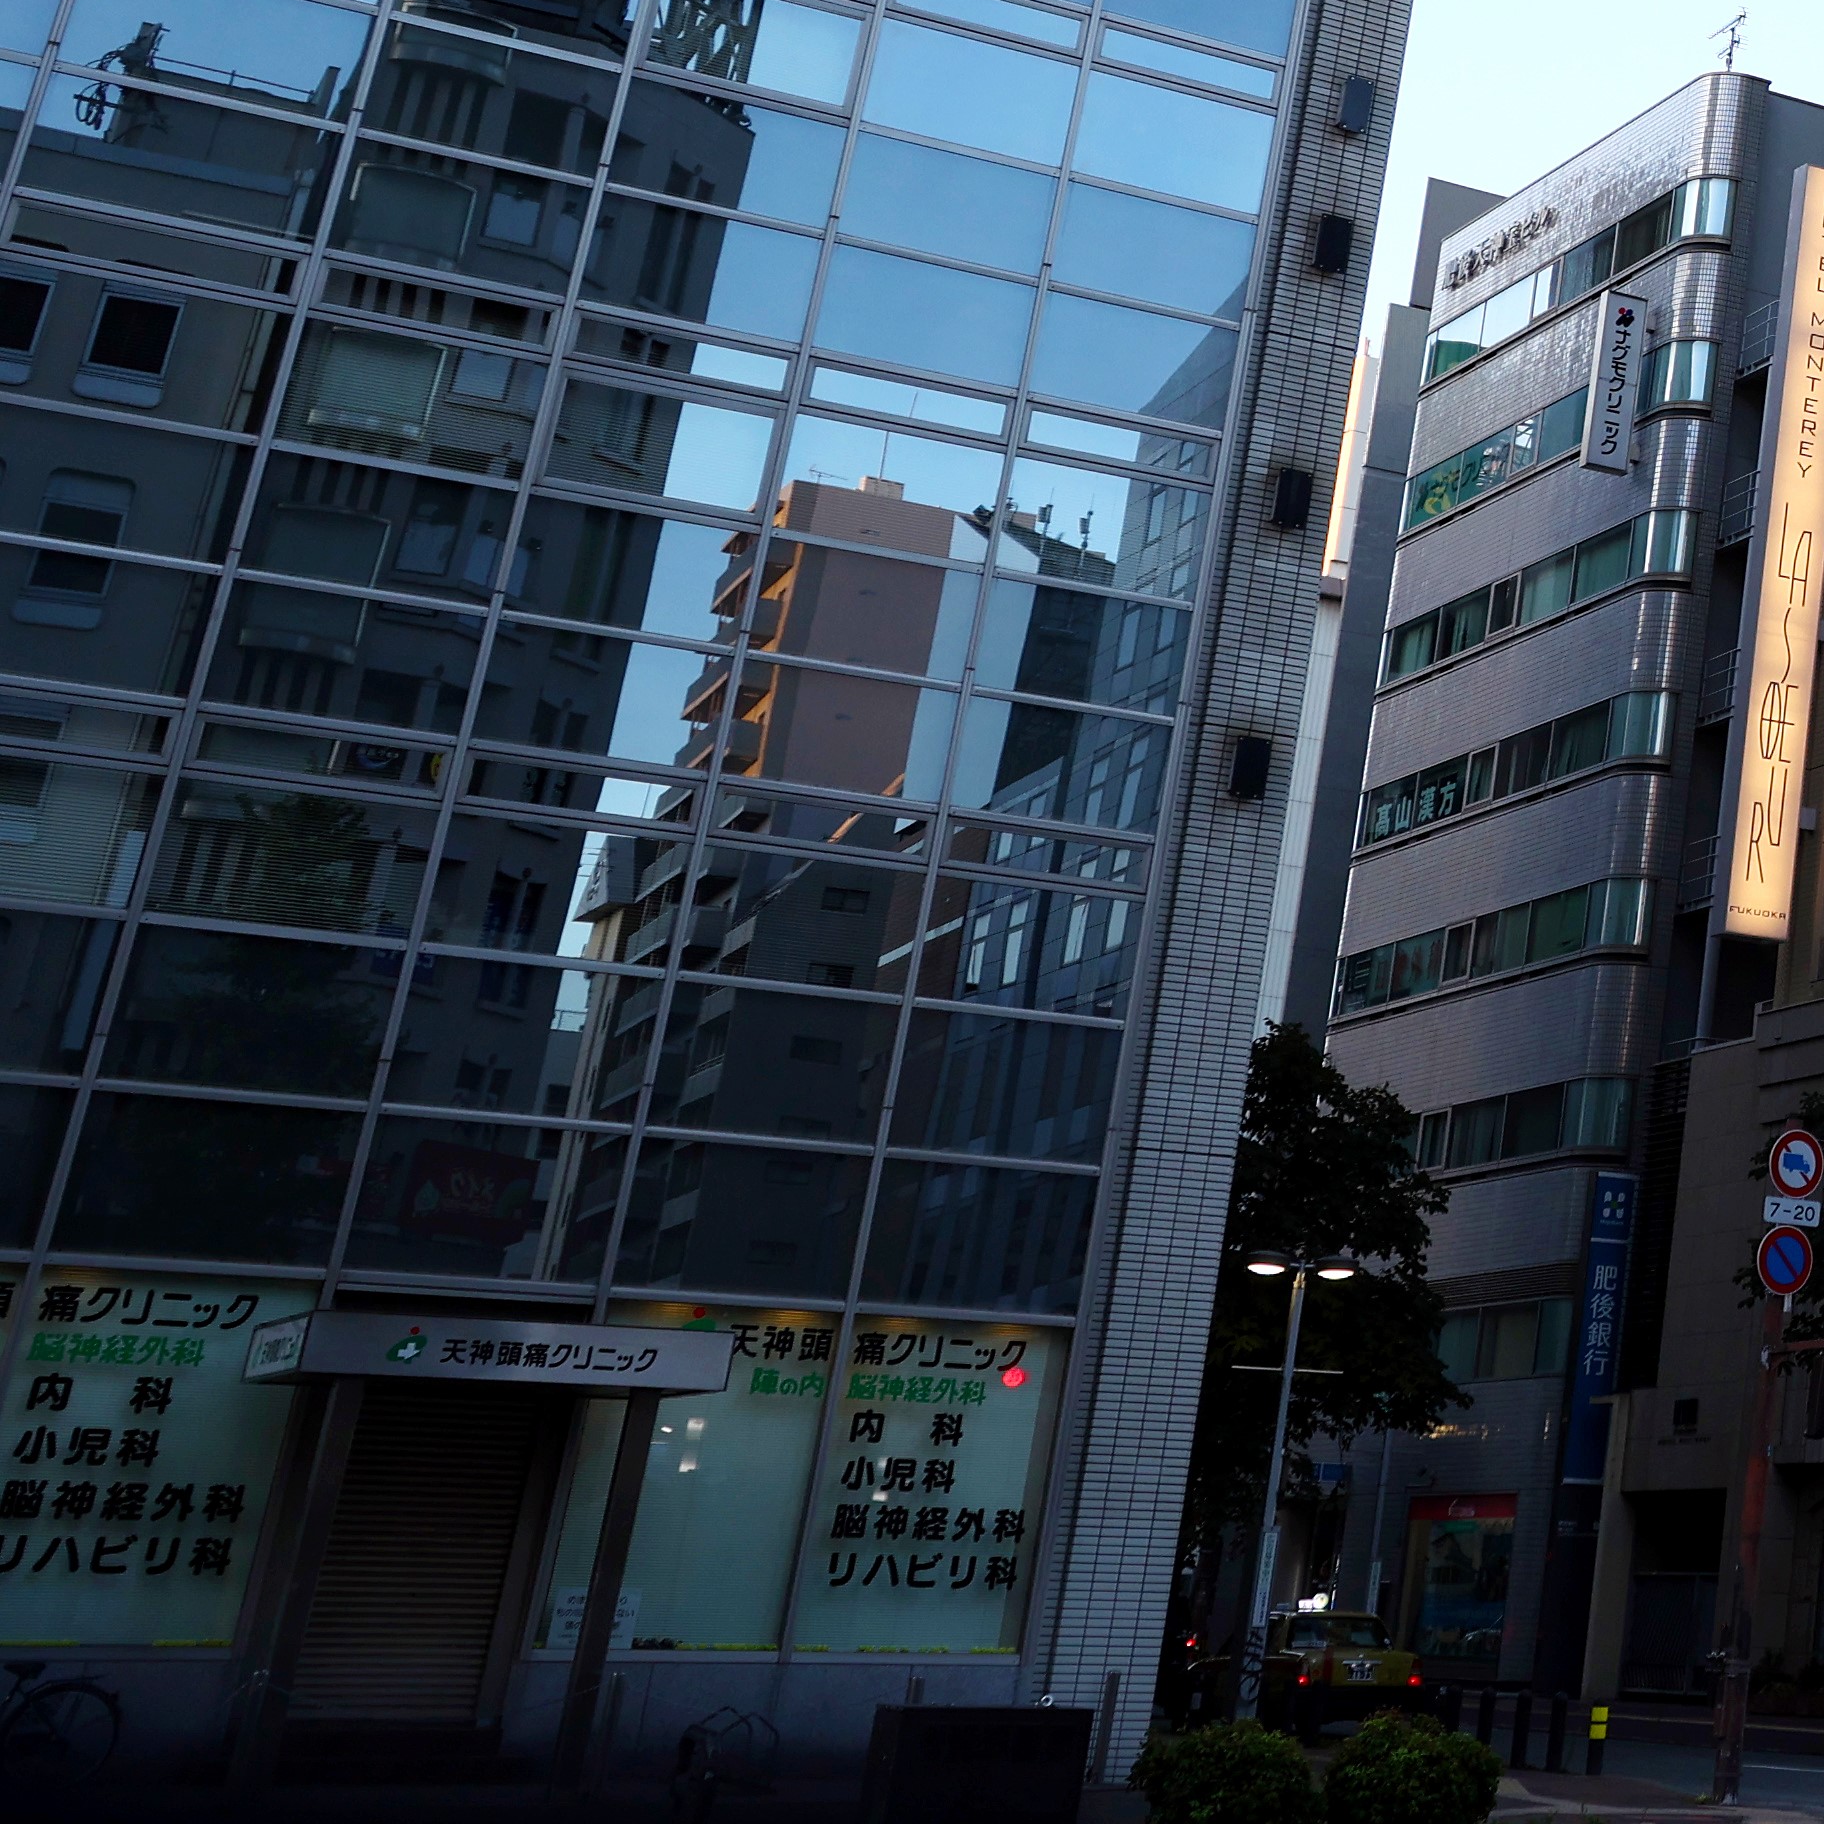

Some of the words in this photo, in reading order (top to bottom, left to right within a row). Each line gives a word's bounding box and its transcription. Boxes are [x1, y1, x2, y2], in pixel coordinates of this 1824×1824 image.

[1601, 329, 1631, 455] ナグモクリニック
[1778, 502, 1813, 607] LA
[1729, 904, 1787, 920] FUKUOKA
[1769, 1202, 1816, 1221] 7-20
[1583, 1264, 1618, 1376] 肥後銀行
[27, 1332, 205, 1366] 脳神経外科
[440, 1337, 659, 1373] 天神頭痛クリニック
[13, 1426, 160, 1467] 小児科
[840, 1456, 955, 1494] 小児科
[0, 1479, 246, 1523] 脳神経外科
[830, 1503, 1026, 1543] 脳神経外科
[829, 1552, 1017, 1591] リハビリ科
